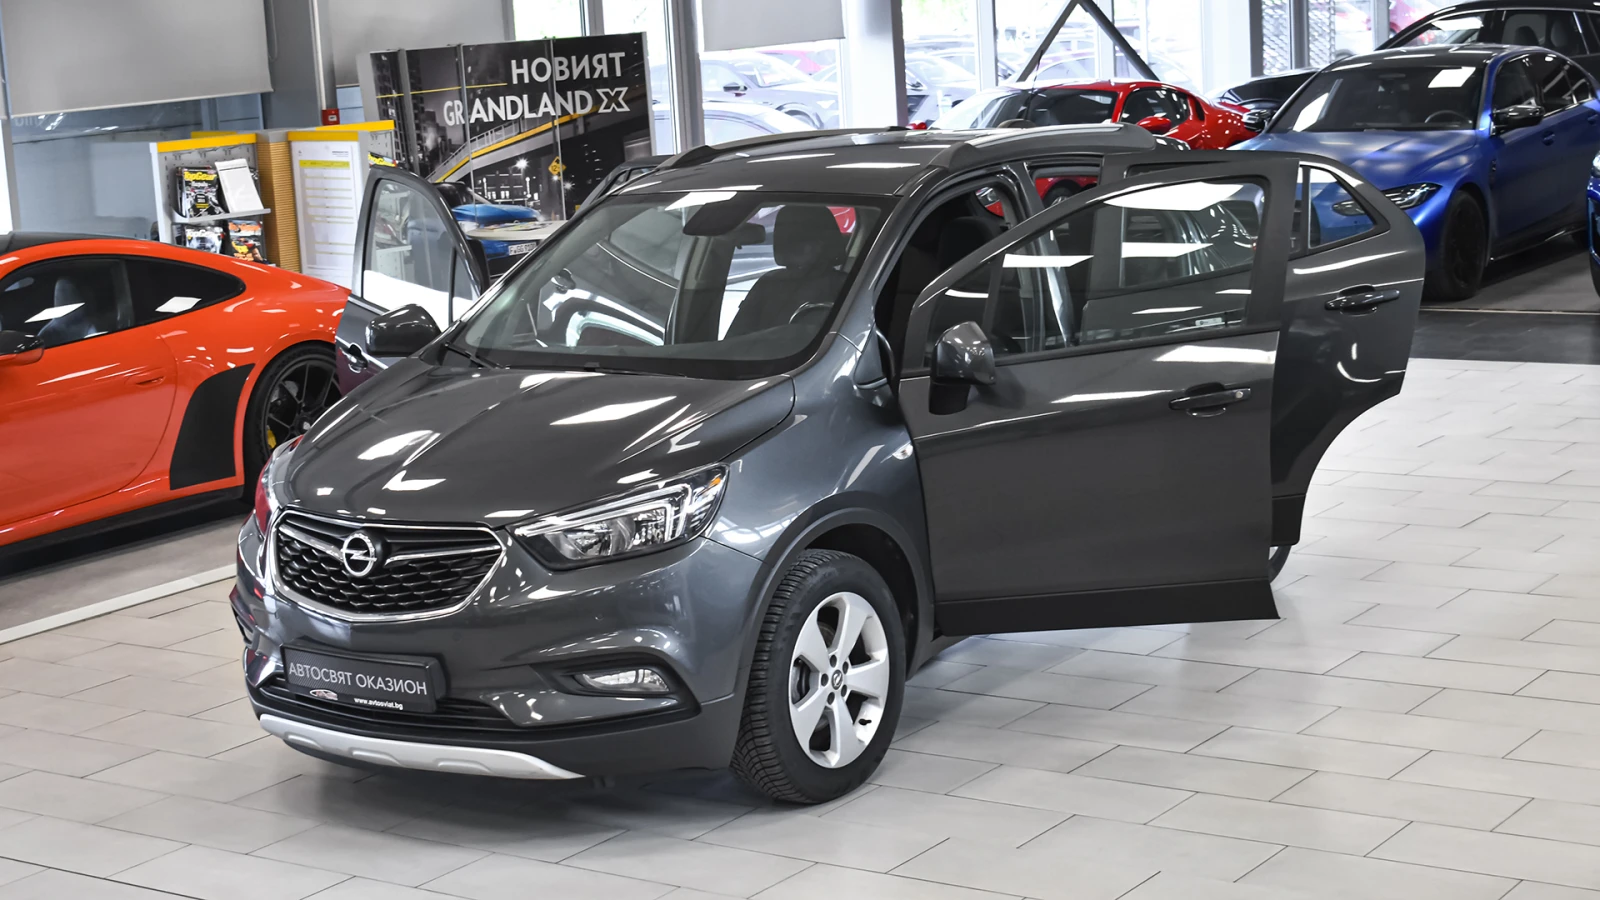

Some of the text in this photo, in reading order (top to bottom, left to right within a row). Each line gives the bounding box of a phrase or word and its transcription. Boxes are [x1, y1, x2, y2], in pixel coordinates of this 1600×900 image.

[510, 52, 626, 84] НОВИЯТ
[443, 87, 631, 126] GRANDLAND X
[184, 171, 217, 182] TopGear
[289, 662, 428, 695] АВТОСВЯТ ОКАЗИОН
[354, 697, 404, 710] www.avtosviat.bg
